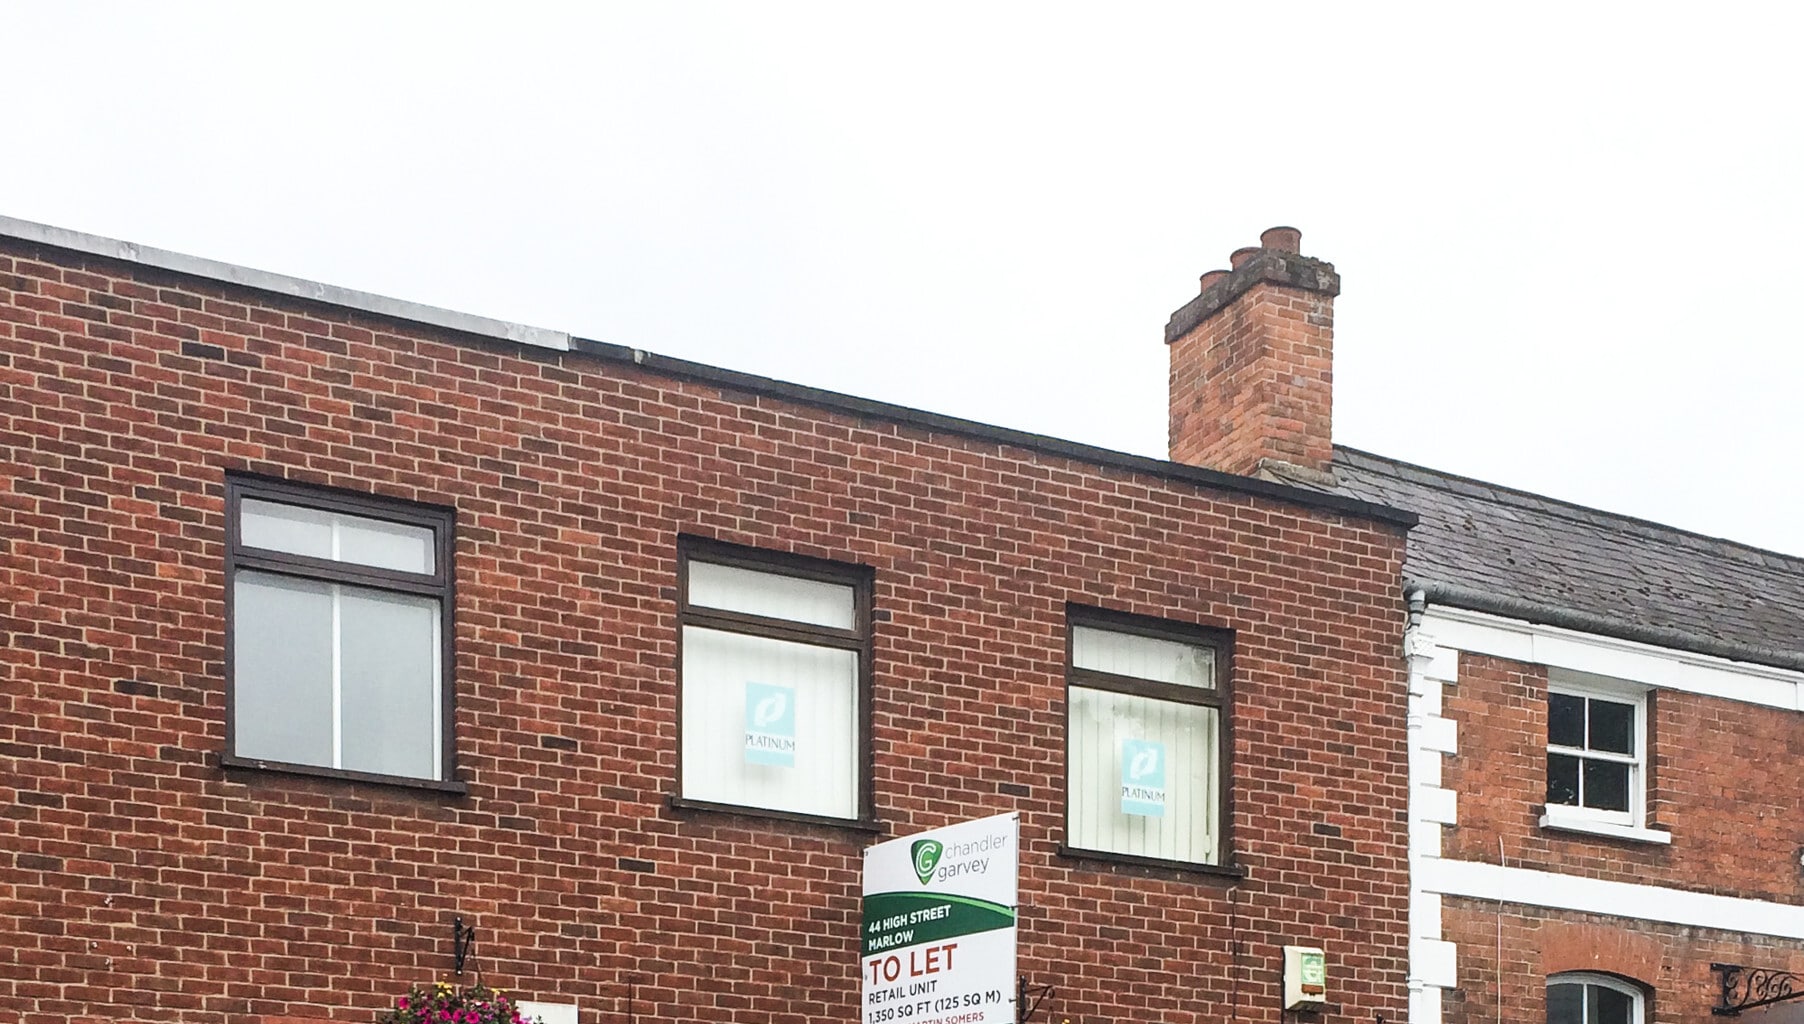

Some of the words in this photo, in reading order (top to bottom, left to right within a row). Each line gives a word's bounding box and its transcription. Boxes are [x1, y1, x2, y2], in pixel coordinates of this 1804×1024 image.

[745, 733, 796, 752] PLATINUM
[1121, 785, 1166, 803] PLATINUM
[945, 833, 1009, 860] chandler
[938, 856, 990, 882] garvey
[868, 919, 881, 934] 44
[883, 914, 907, 931] HIGH
[910, 904, 952, 925] STREET
[868, 929, 914, 951] MARLOW
[869, 958, 901, 986] TO
[910, 943, 958, 978] LET
[868, 986, 906, 1006] RETAIL
[909, 979, 938, 998] UNIT
[897, 1002, 914, 1020] SQ
[916, 999, 932, 1015] FT
[934, 994, 960, 1014] (125
[963, 993, 980, 1009] SQ
[984, 989, 1002, 1006] M)
